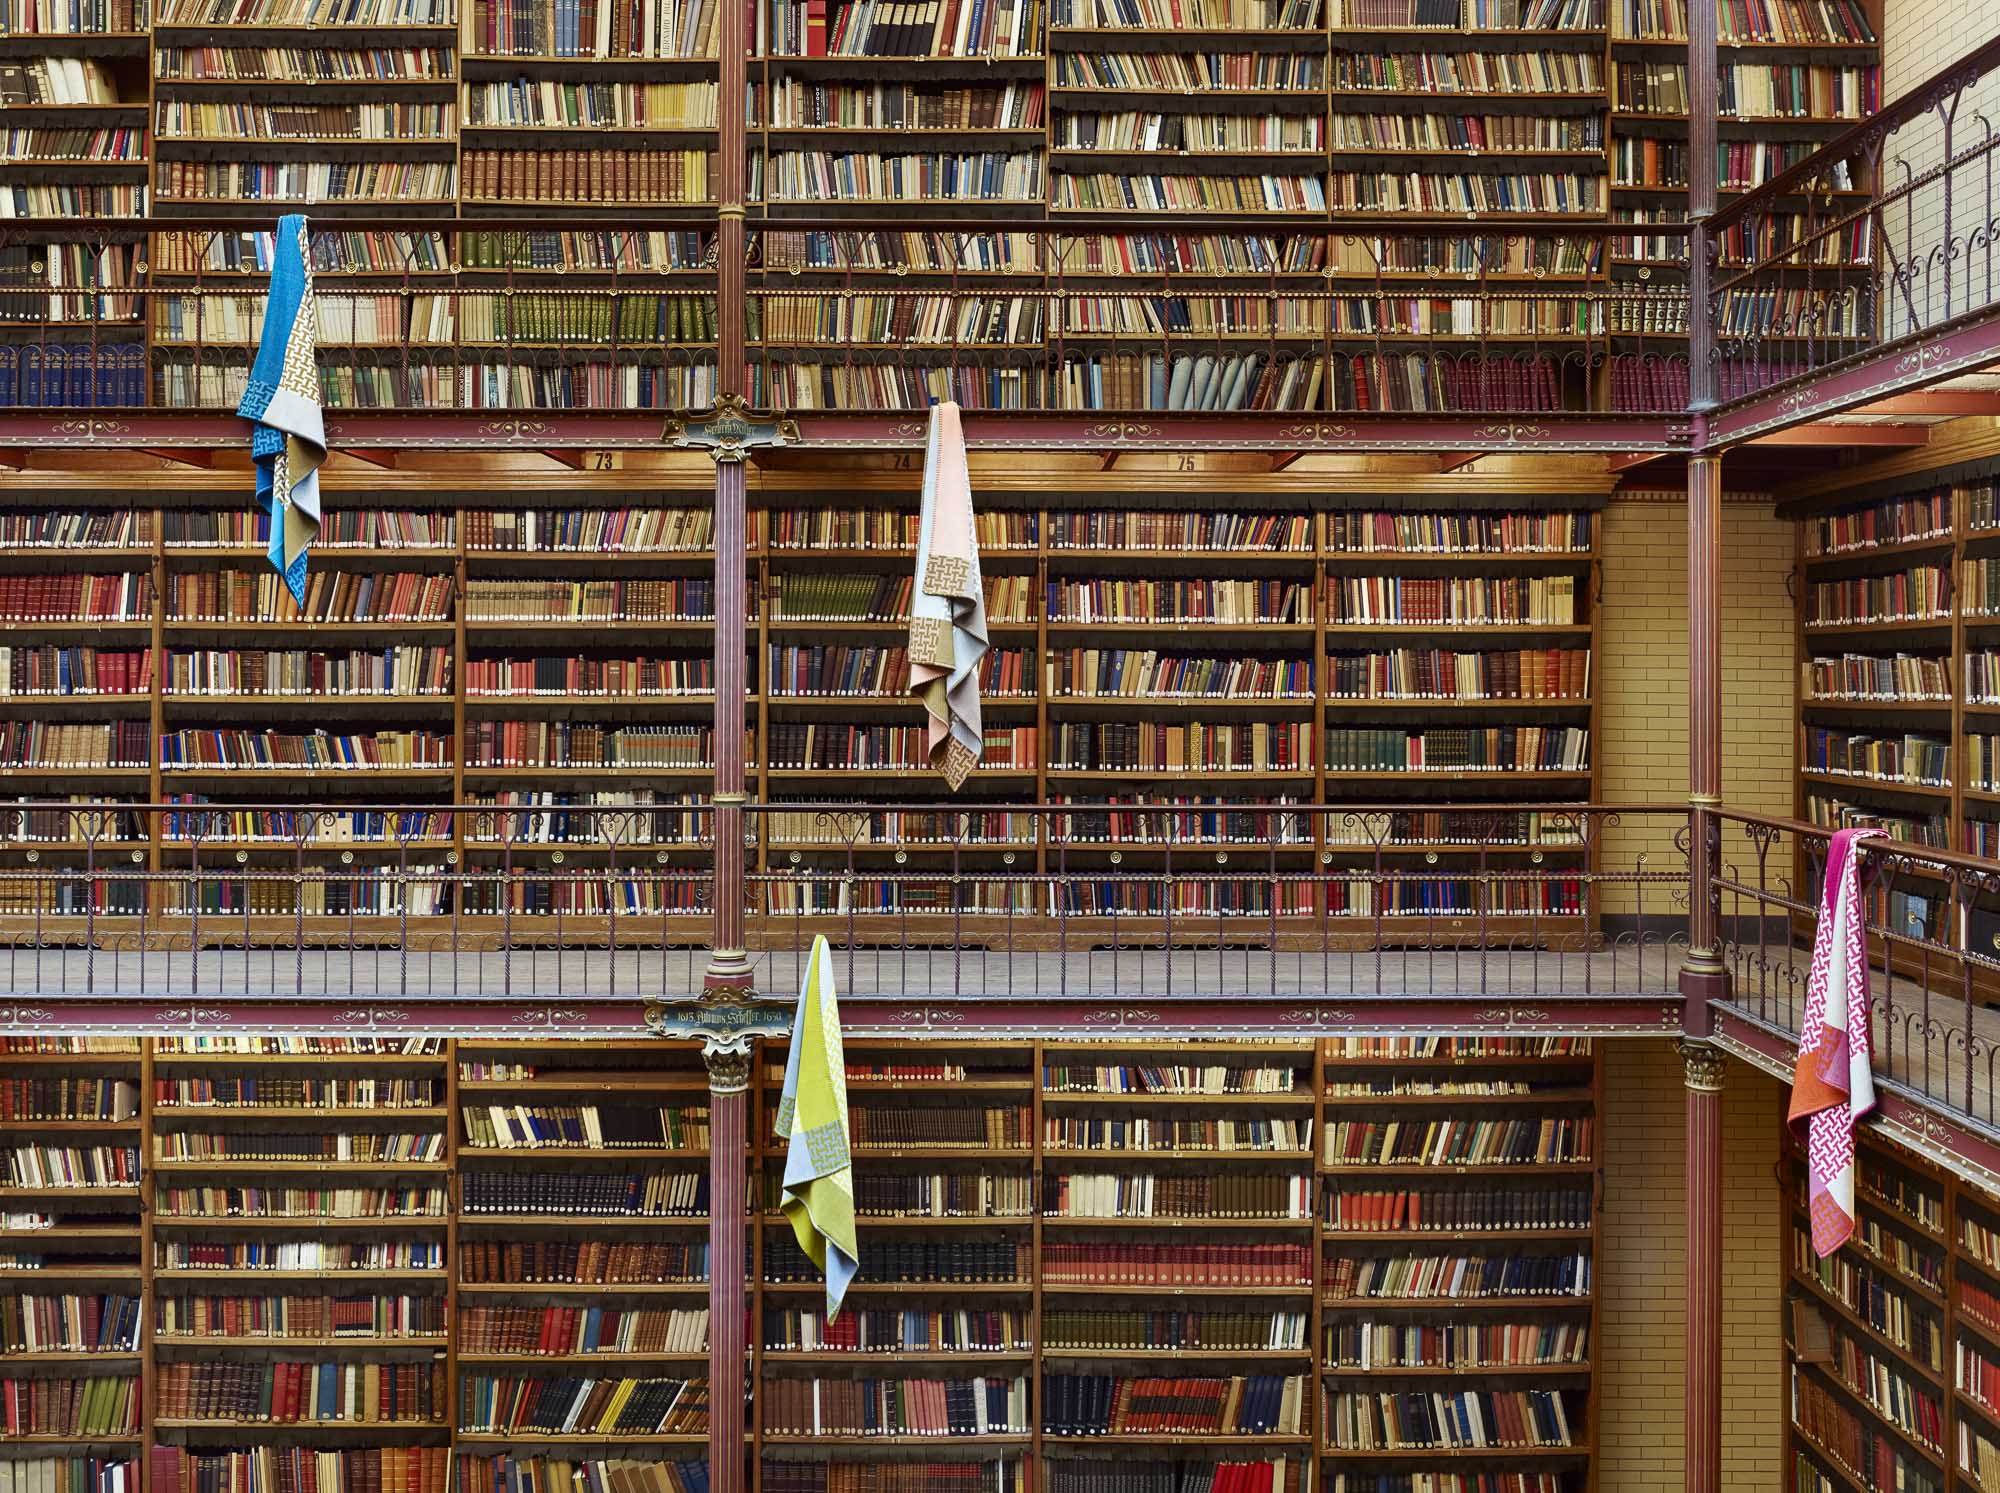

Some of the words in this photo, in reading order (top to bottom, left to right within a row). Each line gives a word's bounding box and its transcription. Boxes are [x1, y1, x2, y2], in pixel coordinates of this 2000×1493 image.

[595, 453, 612, 470] 73
[895, 454, 911, 470] 74
[1178, 455, 1195, 471] 75
